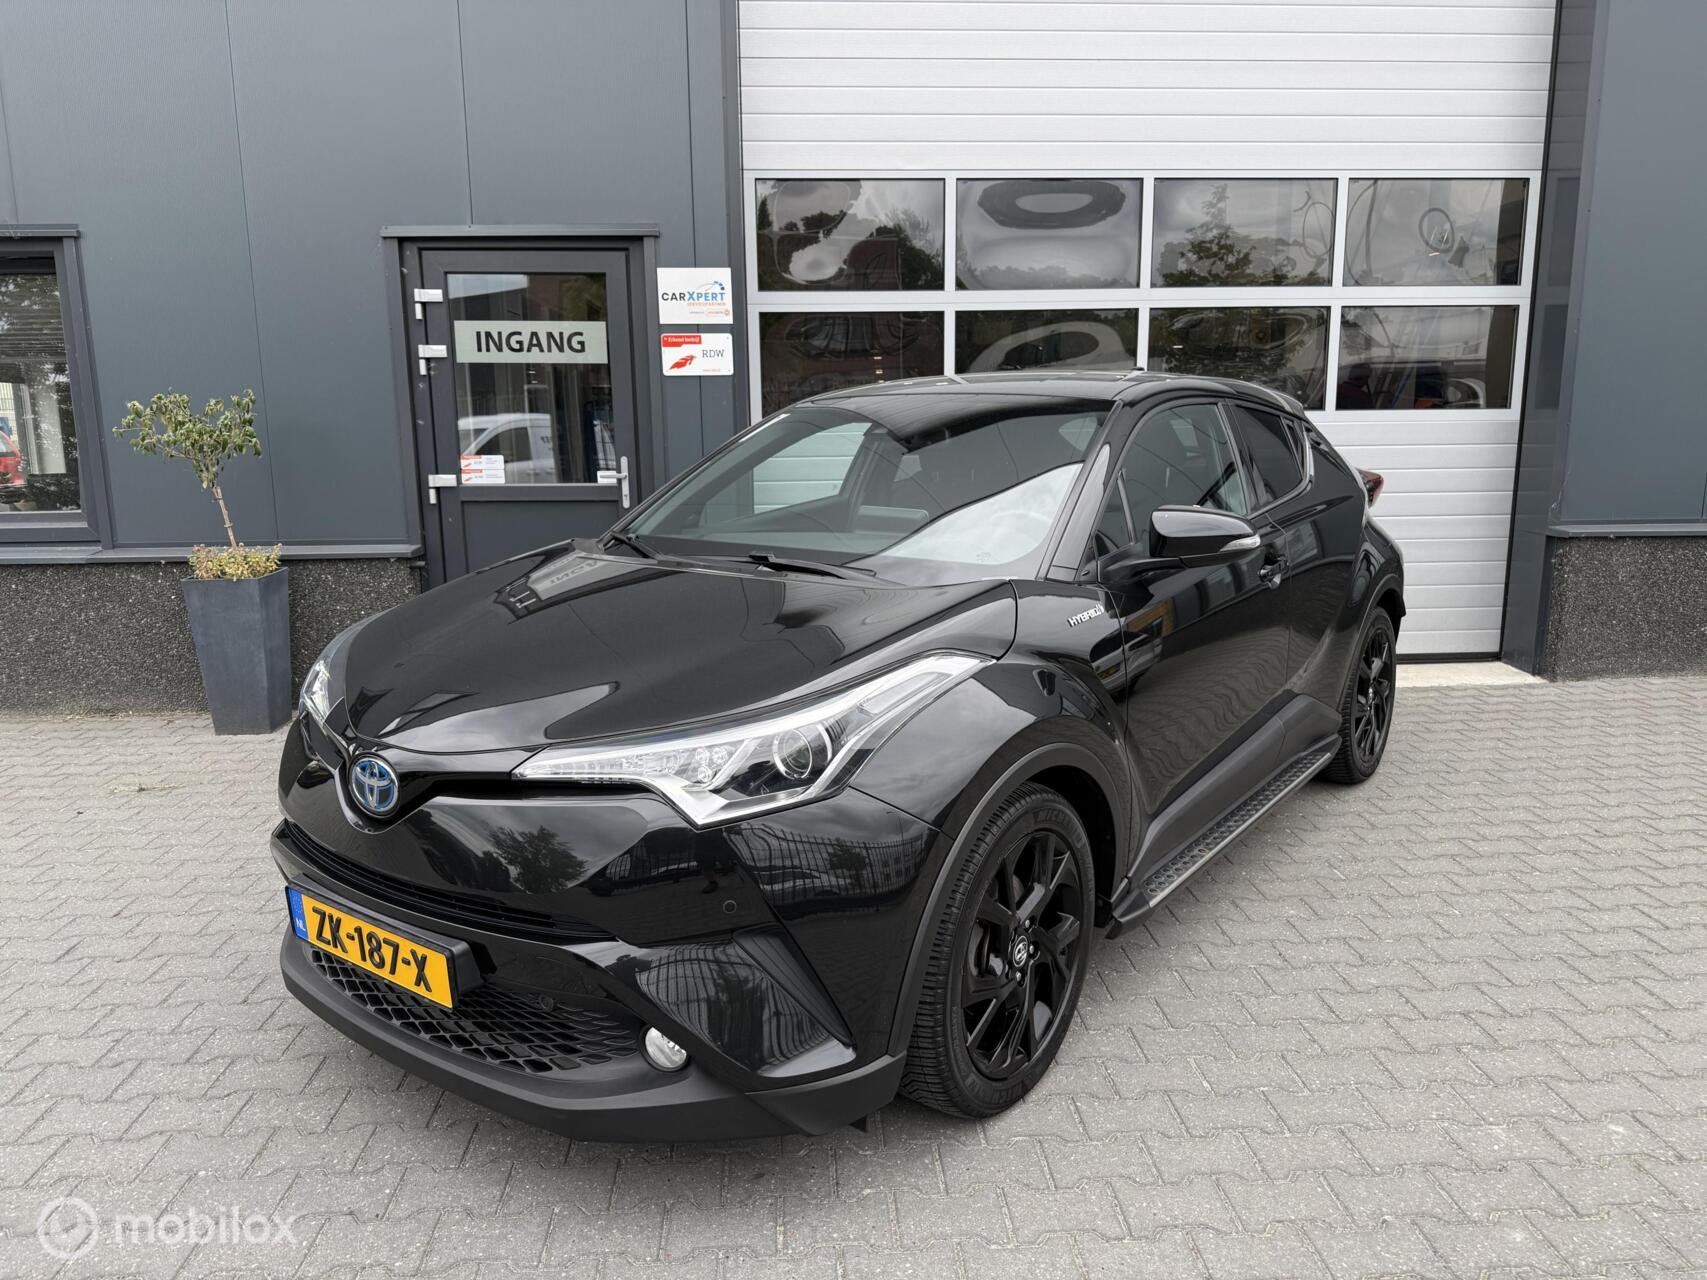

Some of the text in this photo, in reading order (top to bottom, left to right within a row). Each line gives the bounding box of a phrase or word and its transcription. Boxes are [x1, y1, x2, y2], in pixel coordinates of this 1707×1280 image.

[661, 291, 726, 302] CARXPERT
[475, 331, 586, 354] INGANG
[701, 349, 725, 358] RDW
[295, 917, 306, 931] NL
[312, 906, 432, 993] ZK-187-X
